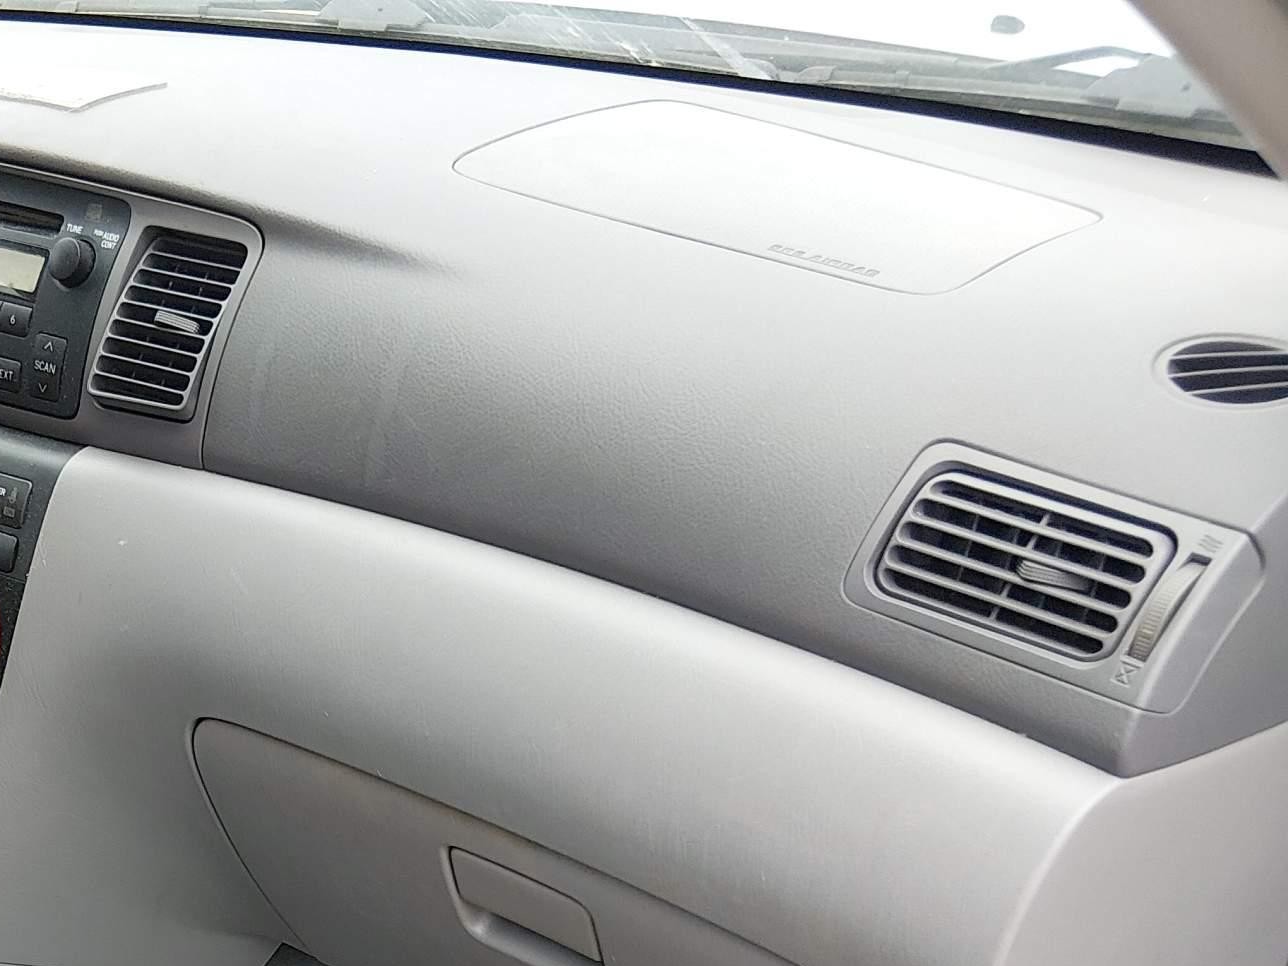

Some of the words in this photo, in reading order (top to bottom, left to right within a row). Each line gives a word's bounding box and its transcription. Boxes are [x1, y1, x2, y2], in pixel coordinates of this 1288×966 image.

[66, 223, 84, 234] TUNE
[10, 314, 16, 325] 6
[34, 360, 57, 375] SCAN
